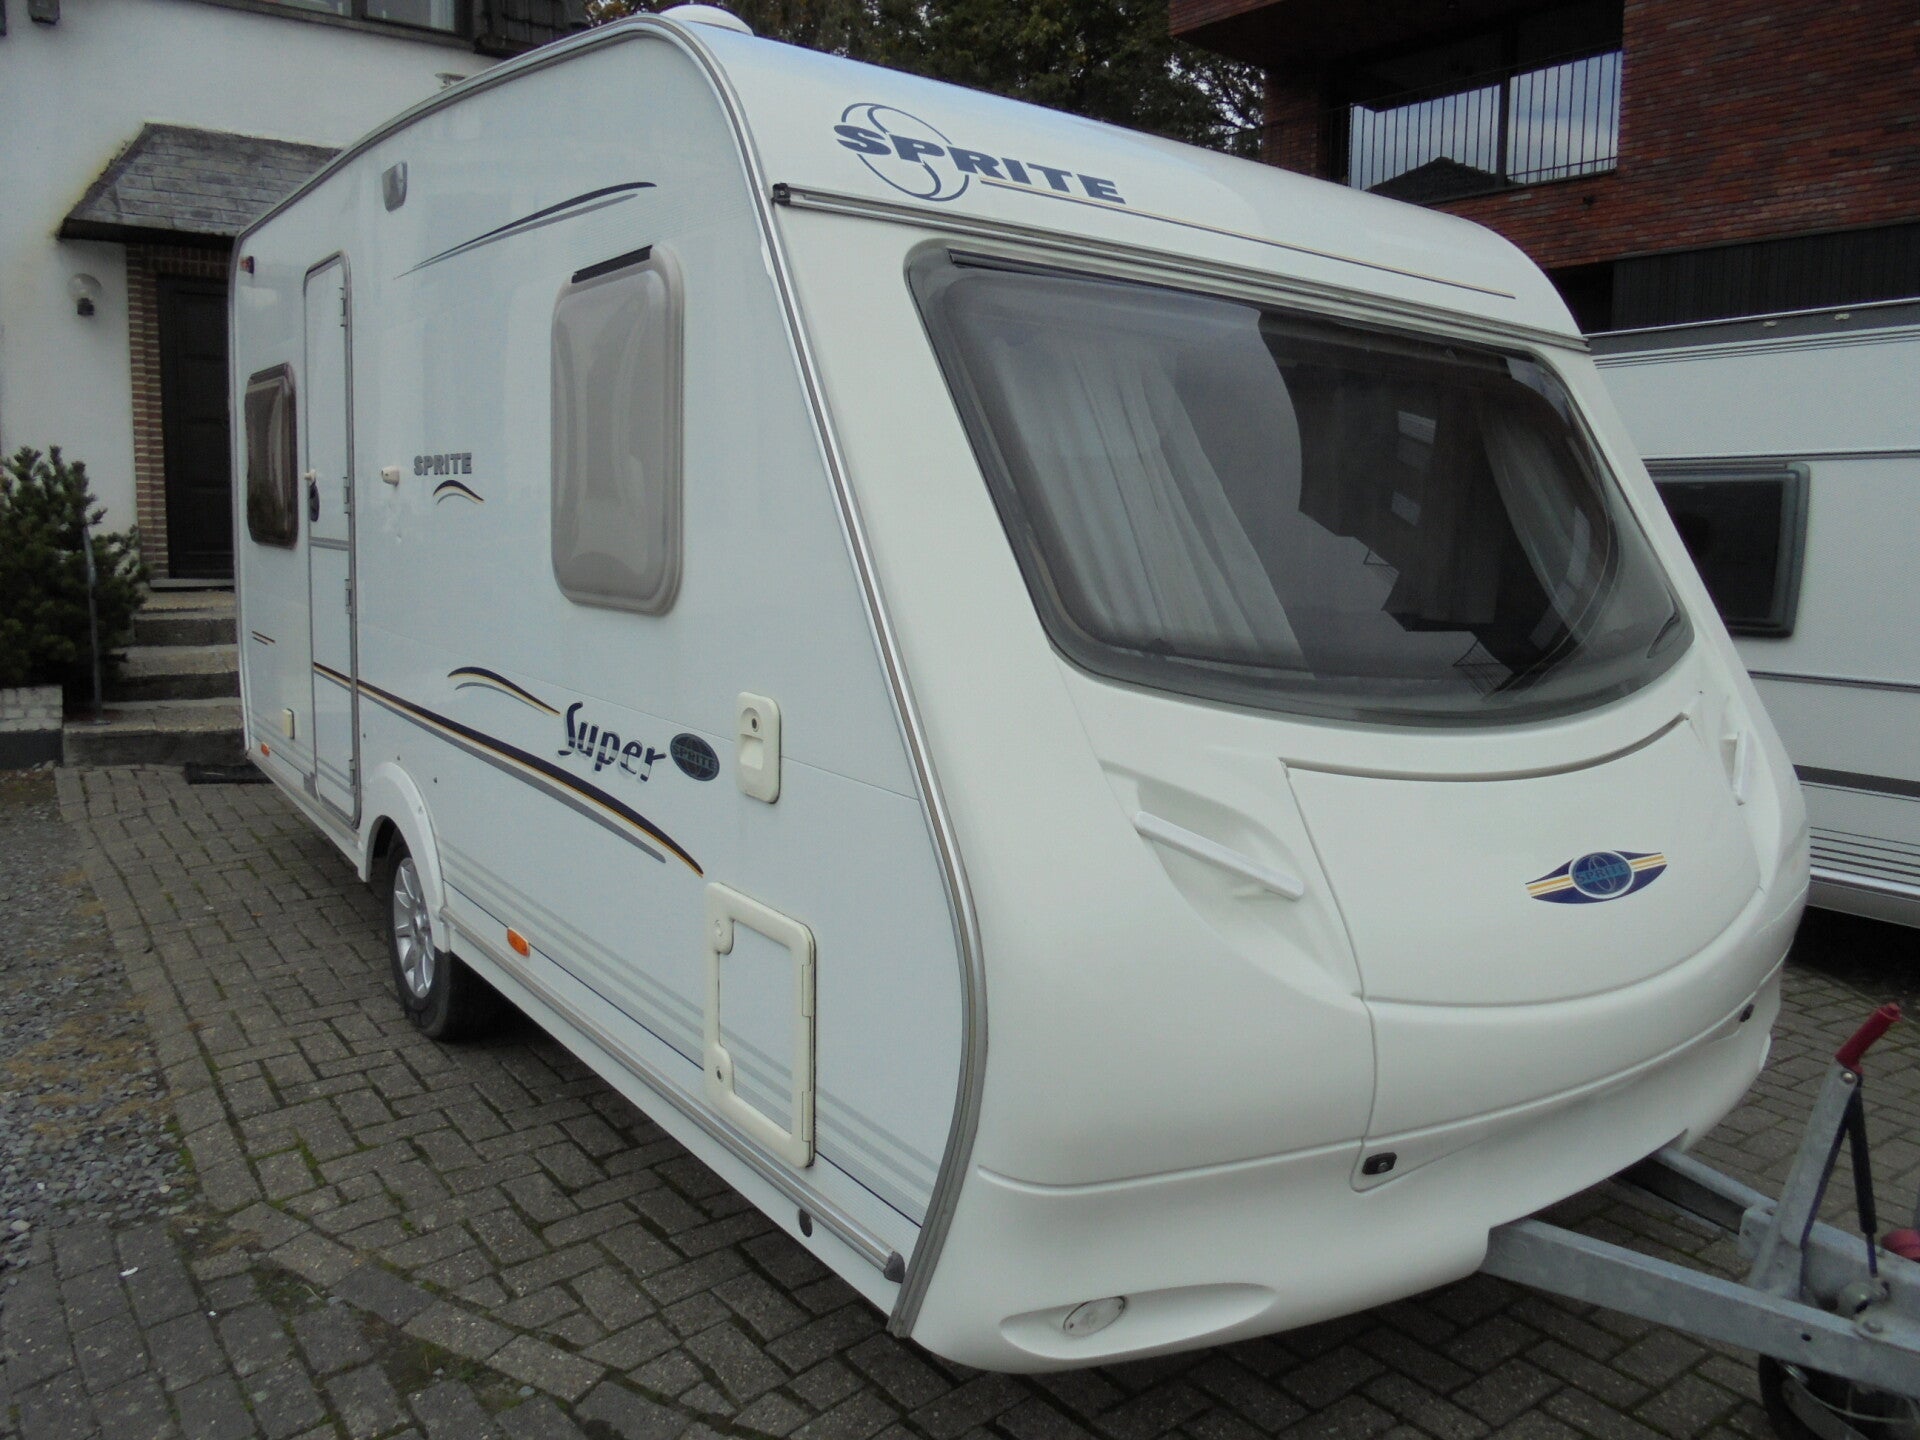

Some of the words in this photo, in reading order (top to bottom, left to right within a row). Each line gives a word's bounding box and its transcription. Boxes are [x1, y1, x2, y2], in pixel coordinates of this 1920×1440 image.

[833, 124, 1126, 204] SPRITE
[413, 452, 472, 476] SPRITE
[557, 701, 667, 782] Super
[673, 743, 717, 770] SPRITE
[1576, 863, 1627, 883] SPRITE
